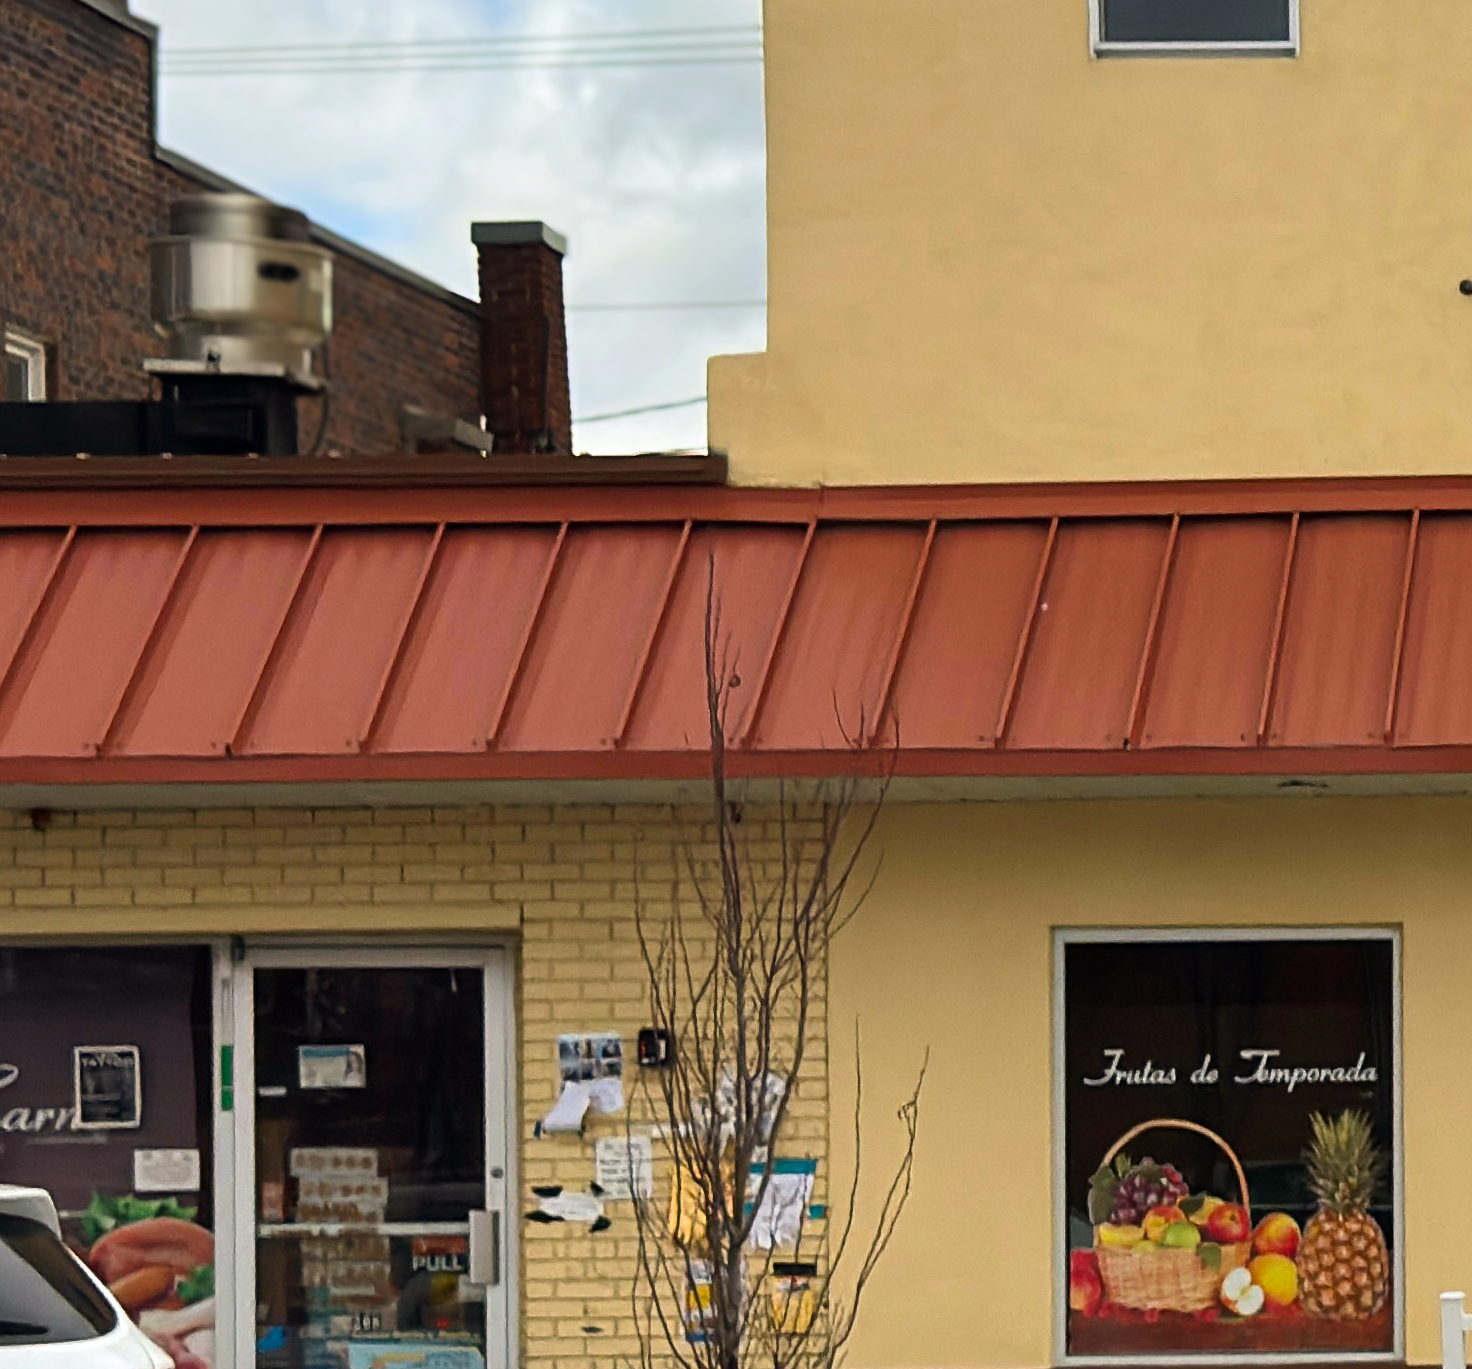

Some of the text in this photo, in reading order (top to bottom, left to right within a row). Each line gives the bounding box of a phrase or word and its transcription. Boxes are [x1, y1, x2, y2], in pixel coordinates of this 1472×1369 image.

[1084, 1049, 1379, 1094] Frutas de Temporada
[413, 1253, 463, 1271] PULL
